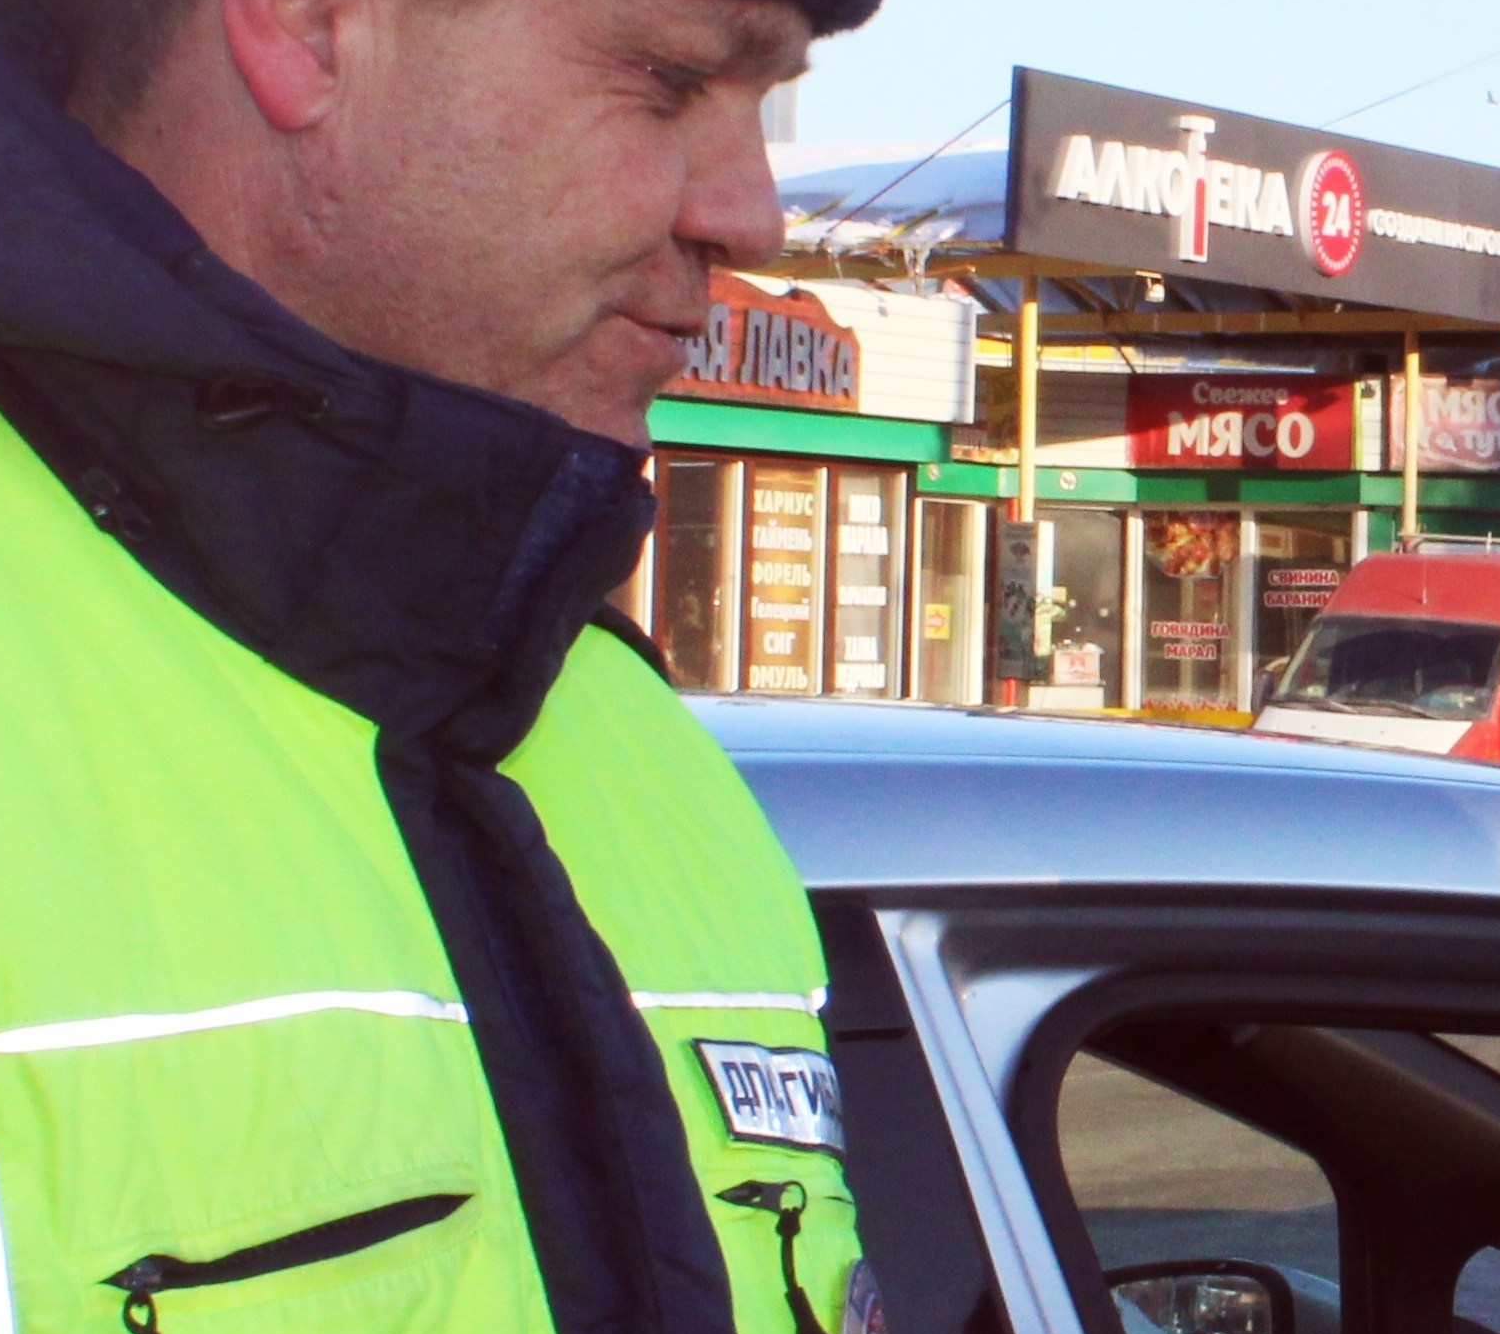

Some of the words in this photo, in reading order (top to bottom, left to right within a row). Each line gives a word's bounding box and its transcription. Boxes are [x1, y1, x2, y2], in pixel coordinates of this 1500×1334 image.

[1322, 190, 1350, 237] 24
[740, 308, 858, 398] ЛАВКА
[1192, 381, 1289, 407] Свежее
[1167, 411, 1314, 461] МЯСО
[753, 489, 814, 515] ХАРИУС
[751, 560, 812, 587] ФОРЕЛЬ
[1268, 569, 1339, 586] СВИНИНА
[763, 631, 797, 656] СИГ
[1151, 621, 1231, 640] ГОВЯДИНА
[1164, 643, 1217, 660] МАРАЛ
[750, 665, 809, 691] ОМУЛЬ
